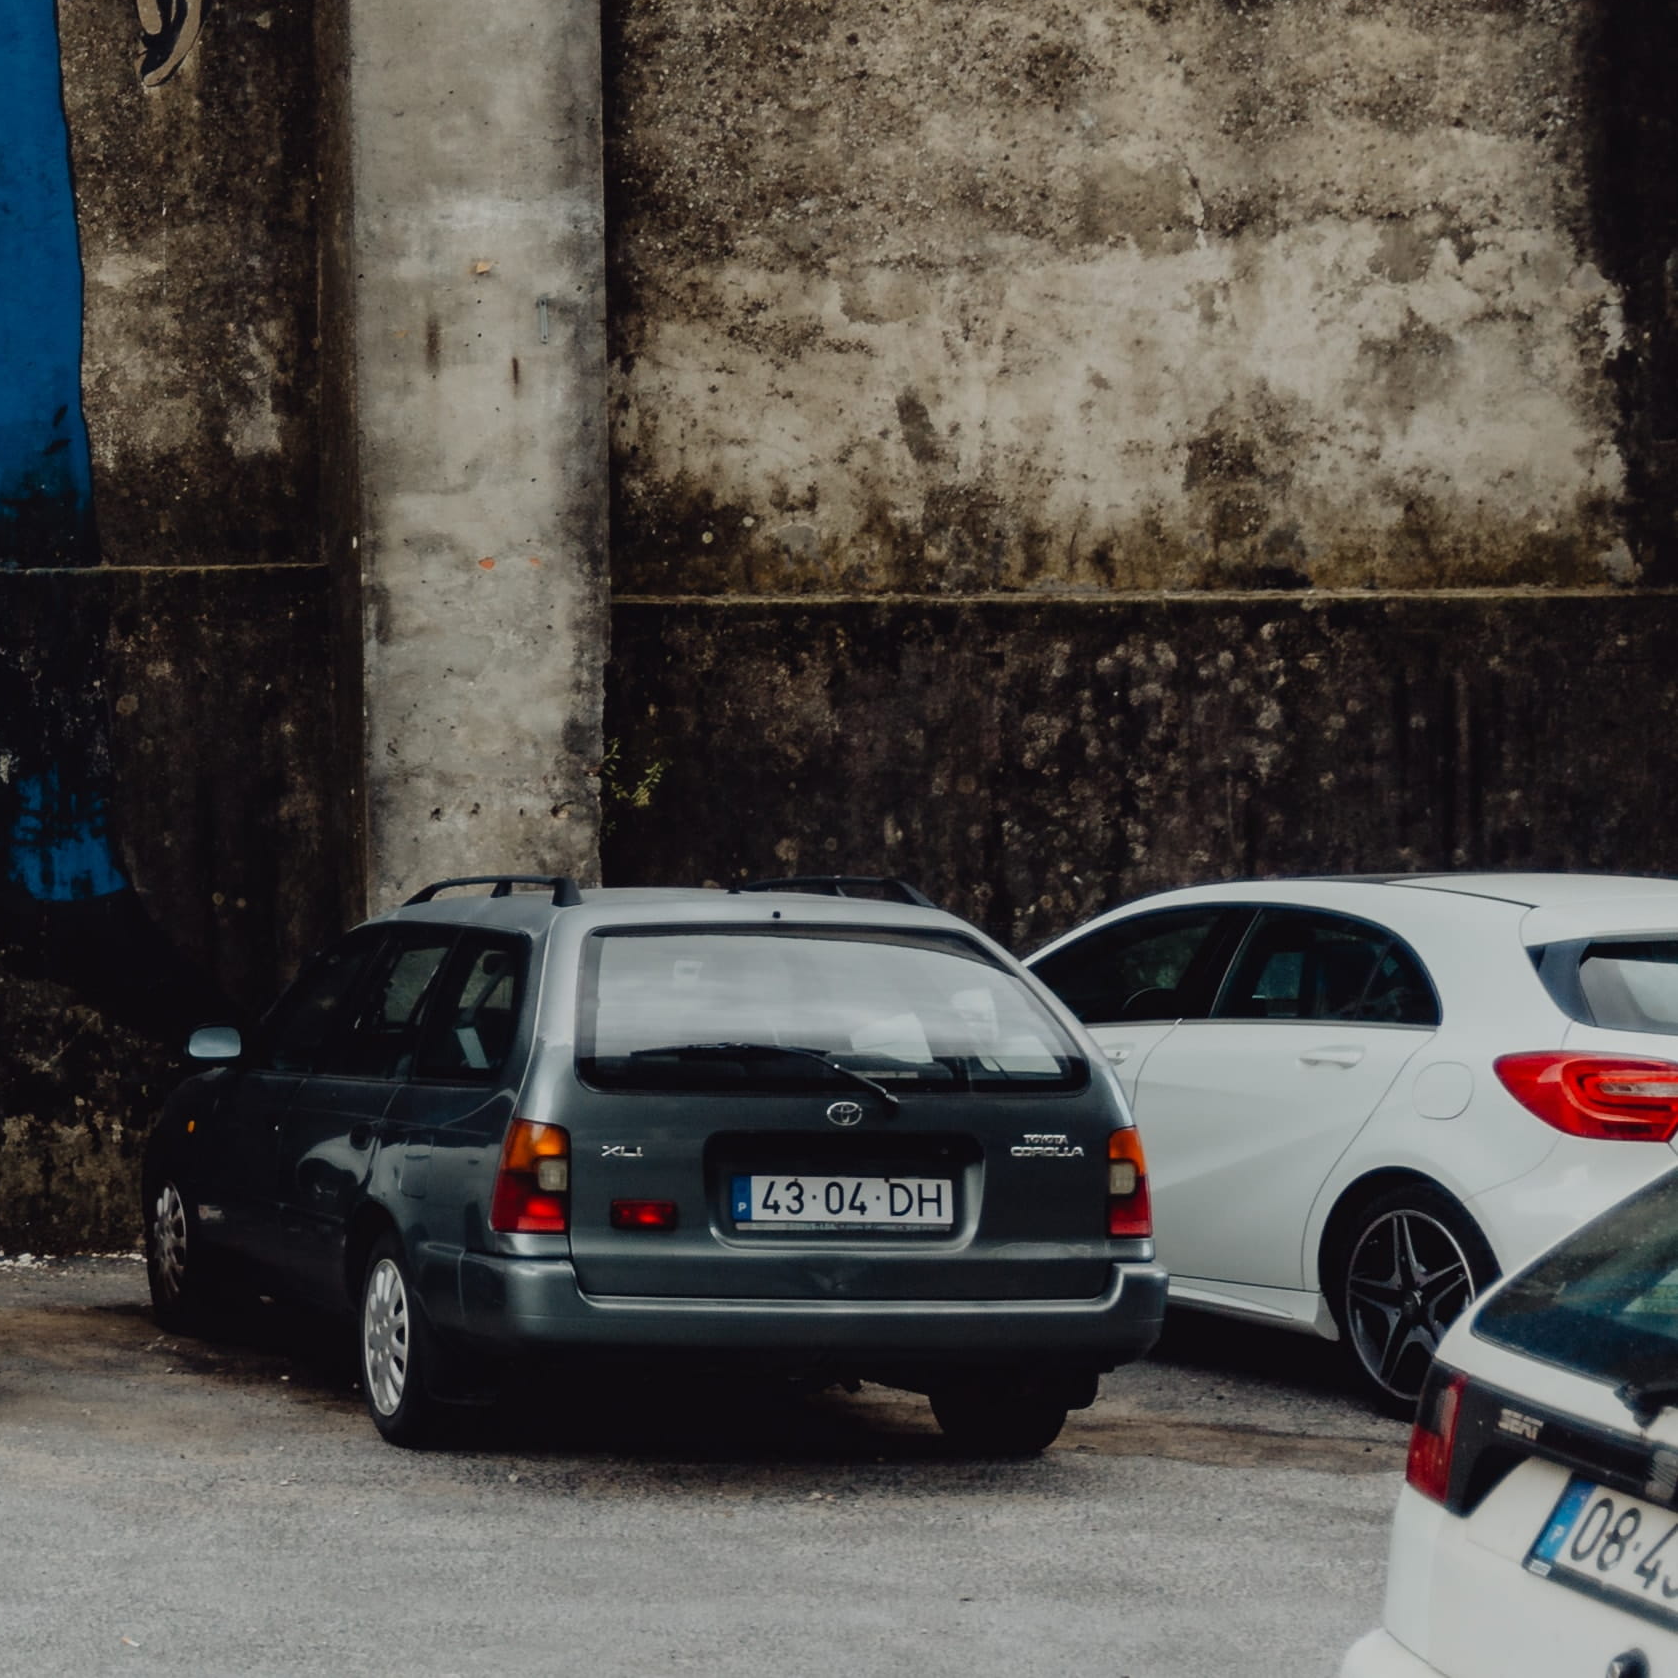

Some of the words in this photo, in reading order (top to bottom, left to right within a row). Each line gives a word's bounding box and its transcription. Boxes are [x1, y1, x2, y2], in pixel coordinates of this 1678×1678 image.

[1022, 1133, 1069, 1144] TOYOTA
[1009, 1146, 1085, 1157] COROLLA
[737, 1201, 748, 1213] P
[1497, 1408, 1544, 1440] SEAT
[1550, 1525, 1565, 1543] P
